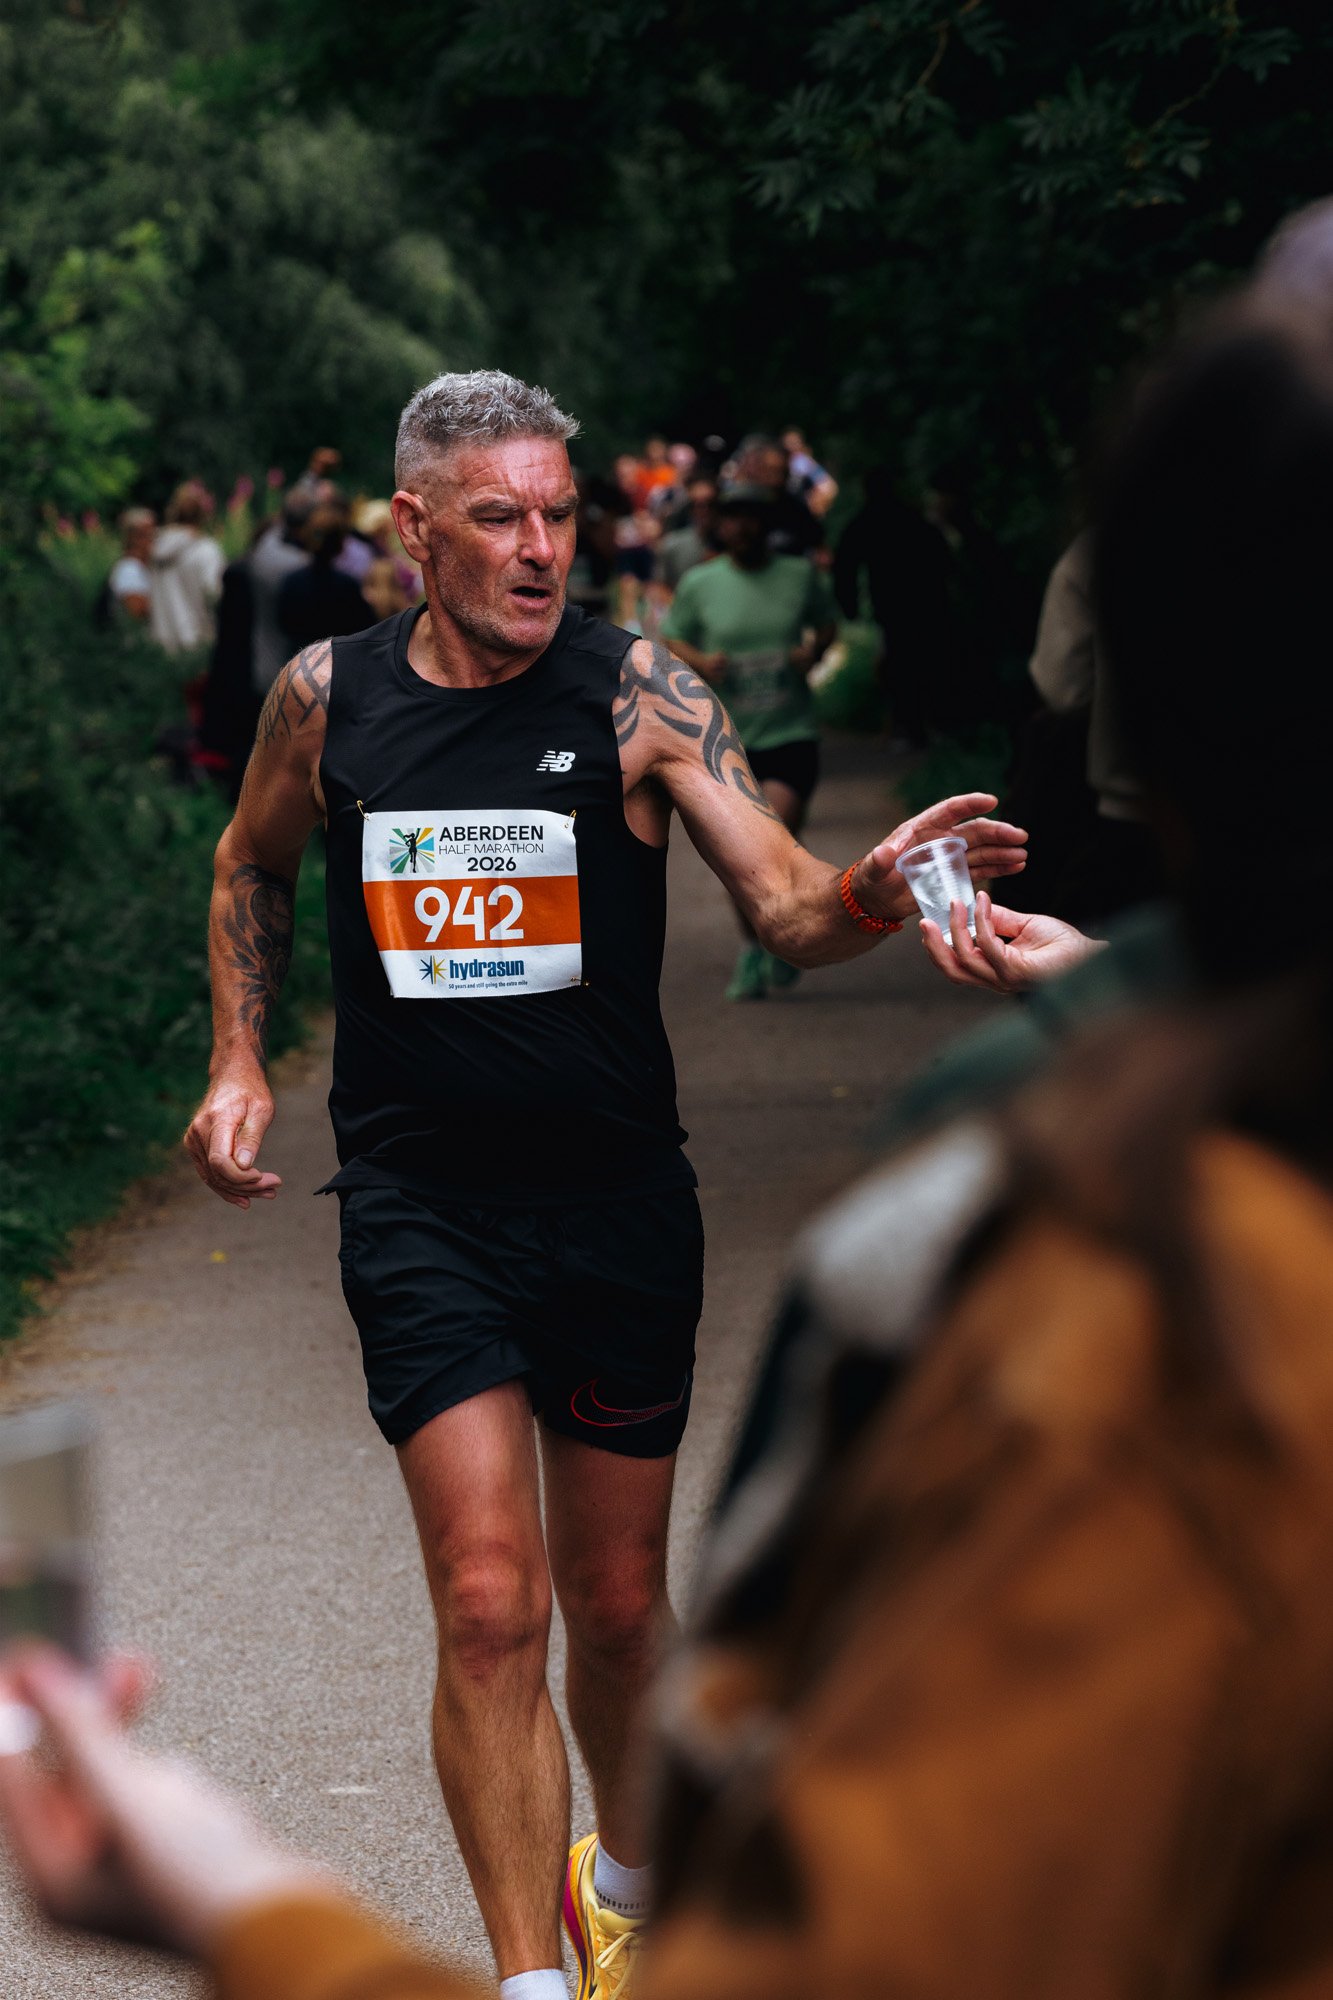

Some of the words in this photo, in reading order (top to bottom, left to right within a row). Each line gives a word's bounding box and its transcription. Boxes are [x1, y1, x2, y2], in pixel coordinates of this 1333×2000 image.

[439, 825, 544, 842] ABERDEEN
[438, 844, 471, 855] HALF
[474, 843, 544, 854] MARATHON
[467, 856, 517, 872] 2026
[414, 884, 525, 943] 942
[449, 958, 525, 981] hydrasun
[485, 981, 498, 989] going
